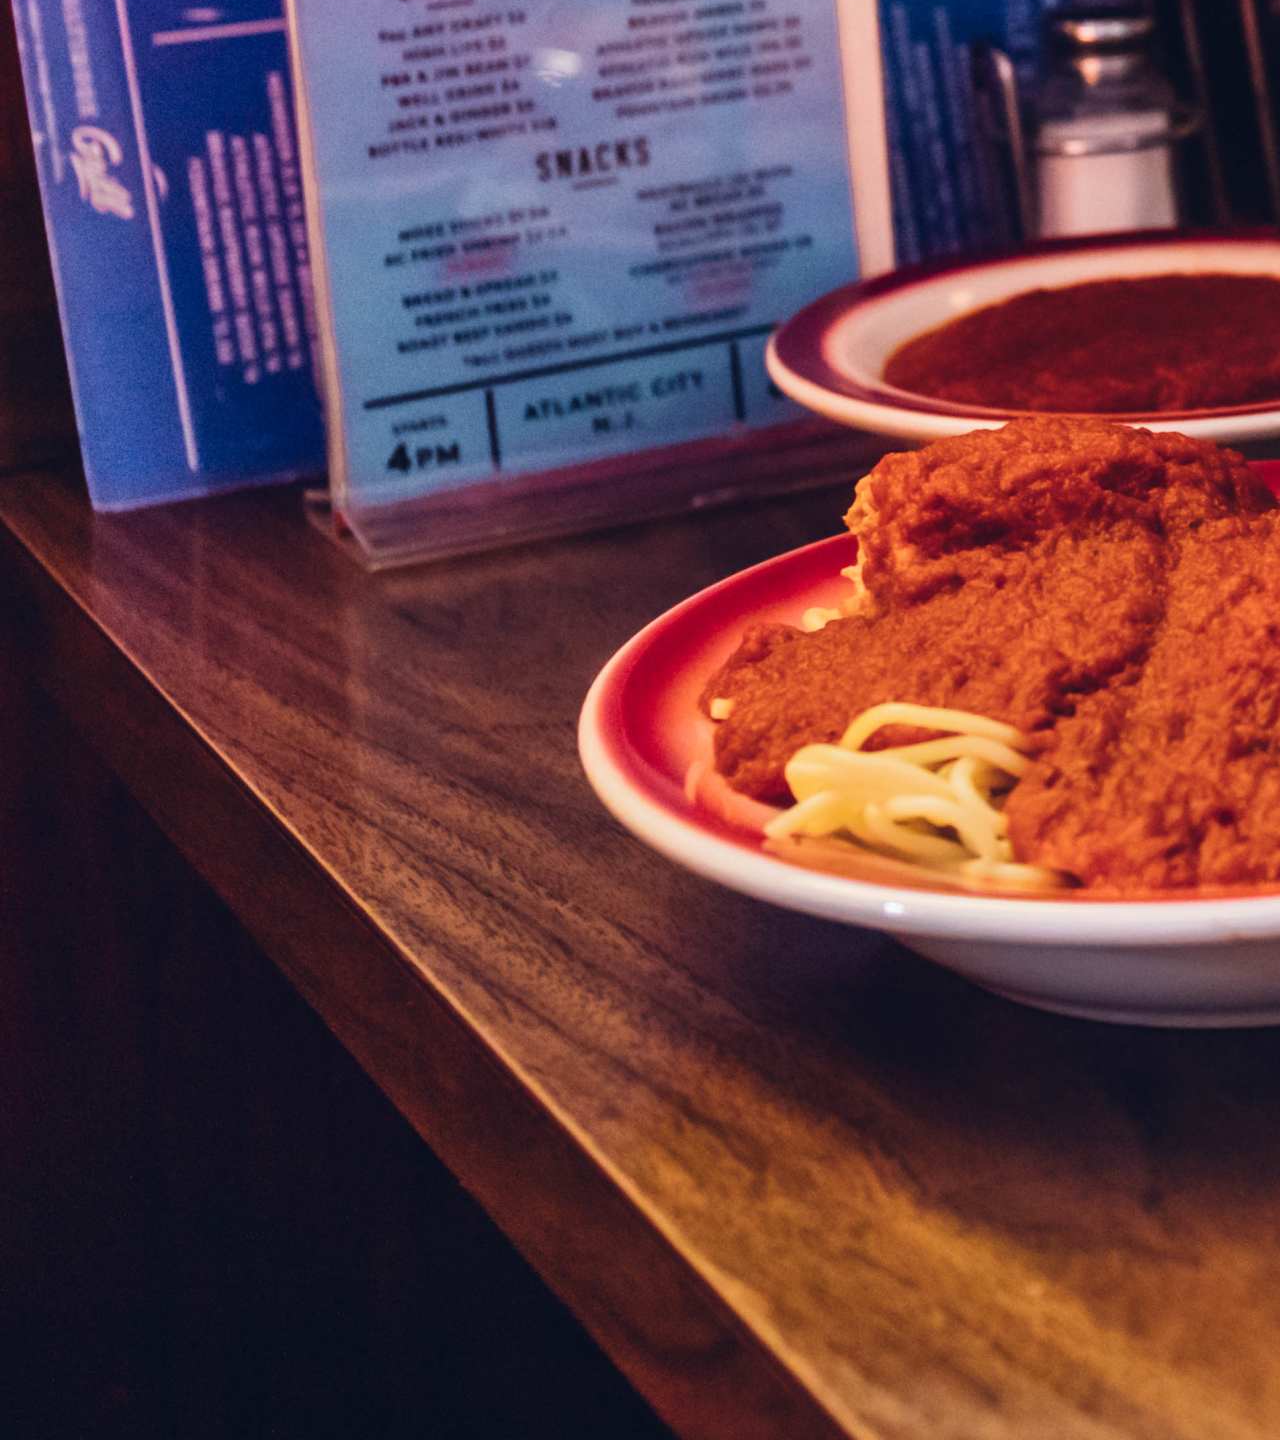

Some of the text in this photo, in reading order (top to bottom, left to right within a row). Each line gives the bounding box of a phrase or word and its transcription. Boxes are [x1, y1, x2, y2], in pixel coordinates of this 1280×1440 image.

[534, 135, 651, 184] SNACKS
[523, 370, 704, 424] ATLANTIC CITY
[386, 440, 460, 474] 4PM
